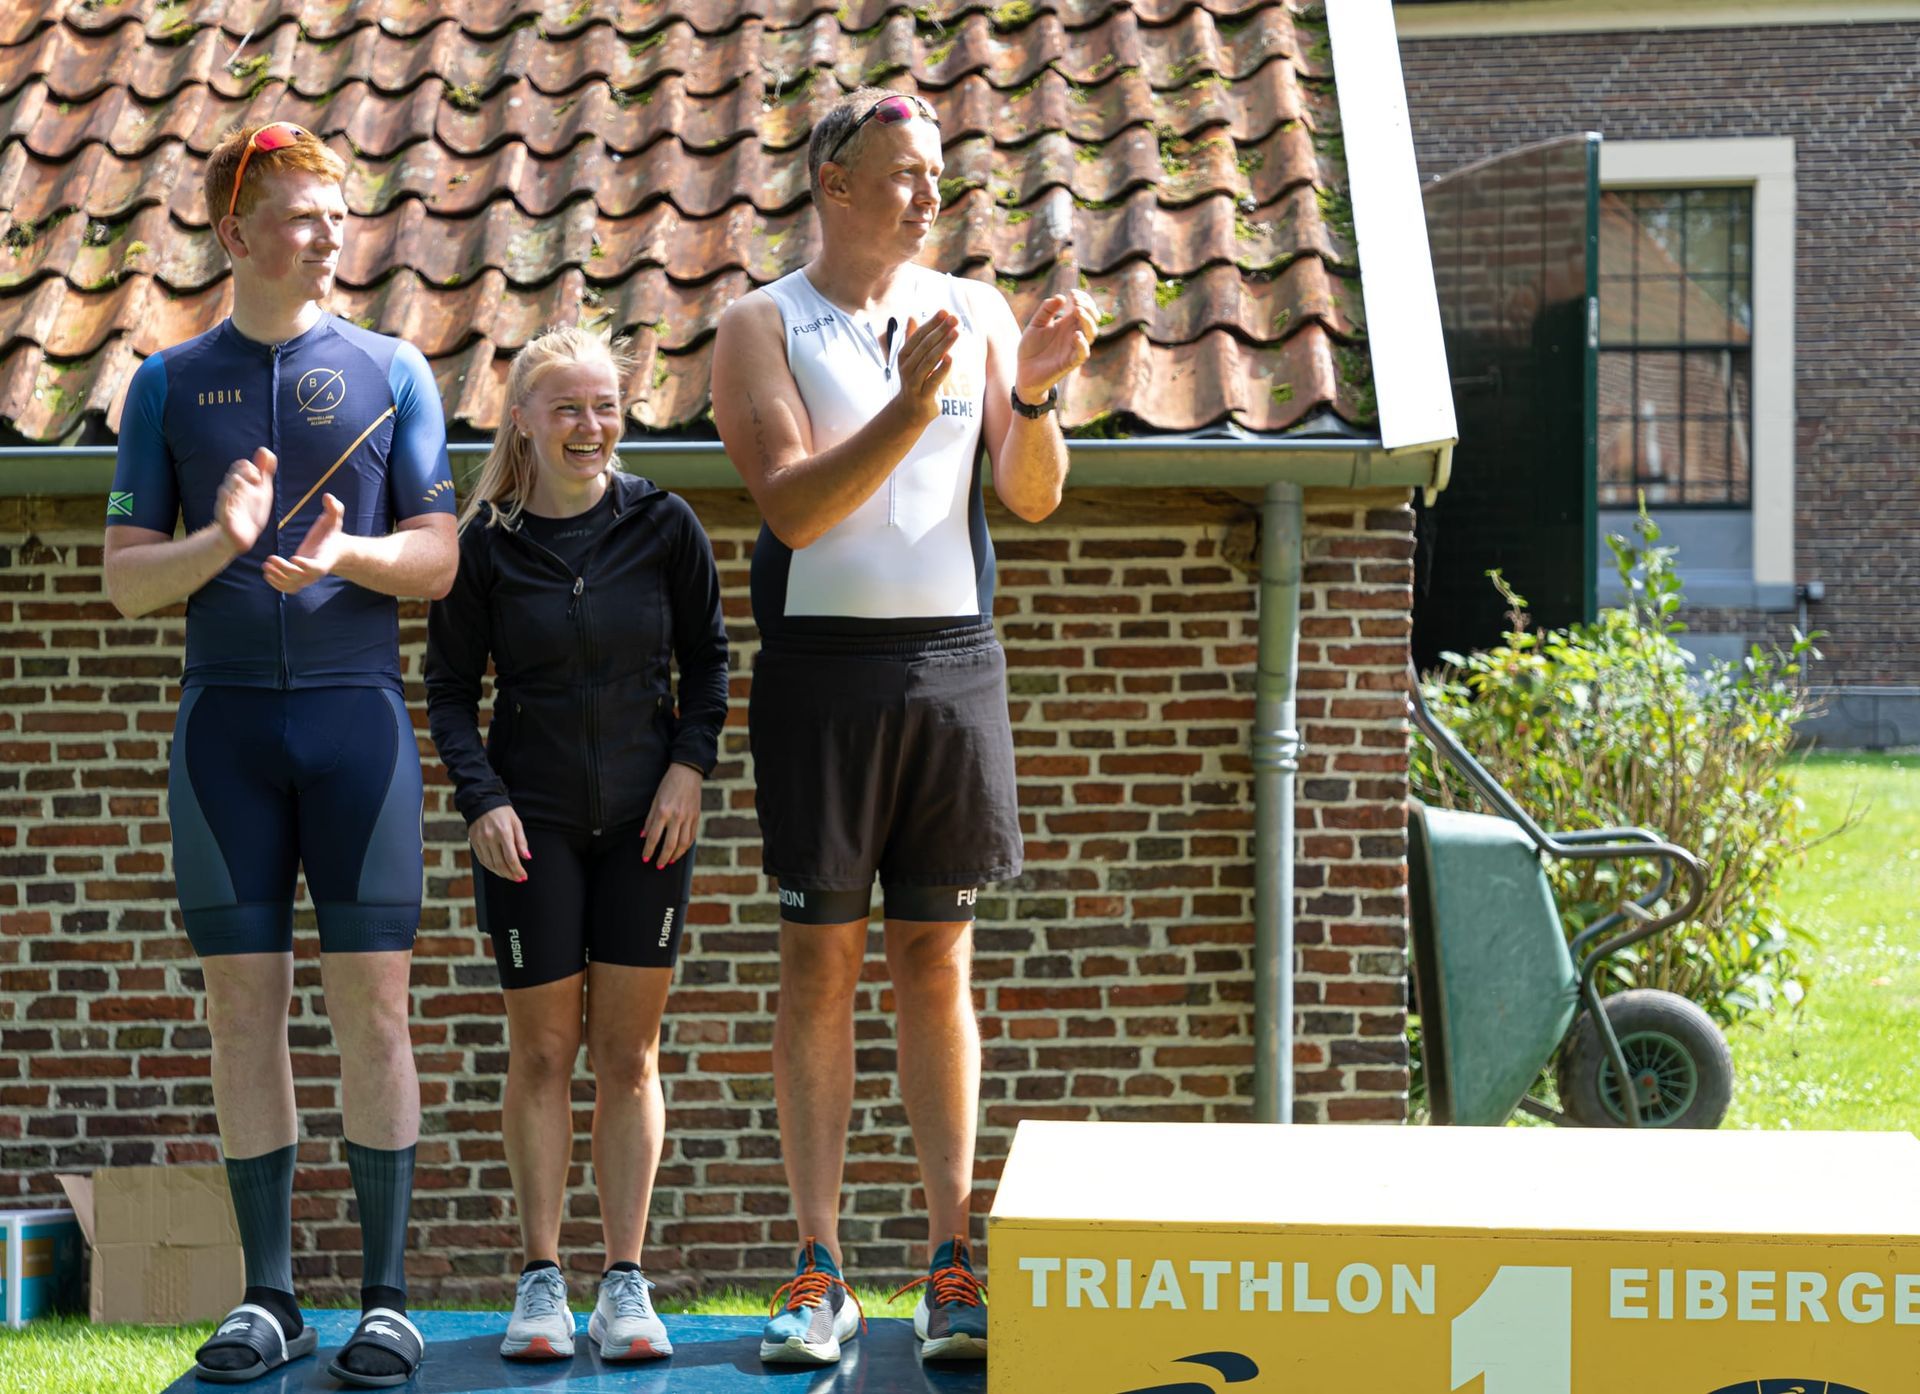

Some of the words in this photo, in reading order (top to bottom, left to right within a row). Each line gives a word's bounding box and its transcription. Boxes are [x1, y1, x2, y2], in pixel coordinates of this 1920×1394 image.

[793, 313, 835, 336] FUSION
[198, 388, 242, 406] GOBIK
[309, 377, 317, 388] B
[326, 391, 334, 401] A
[658, 907, 675, 947] FUSION
[508, 928, 524, 968] FUSION
[1018, 1256, 1436, 1316] TRIATHLON
[1451, 1265, 1572, 1394] 1
